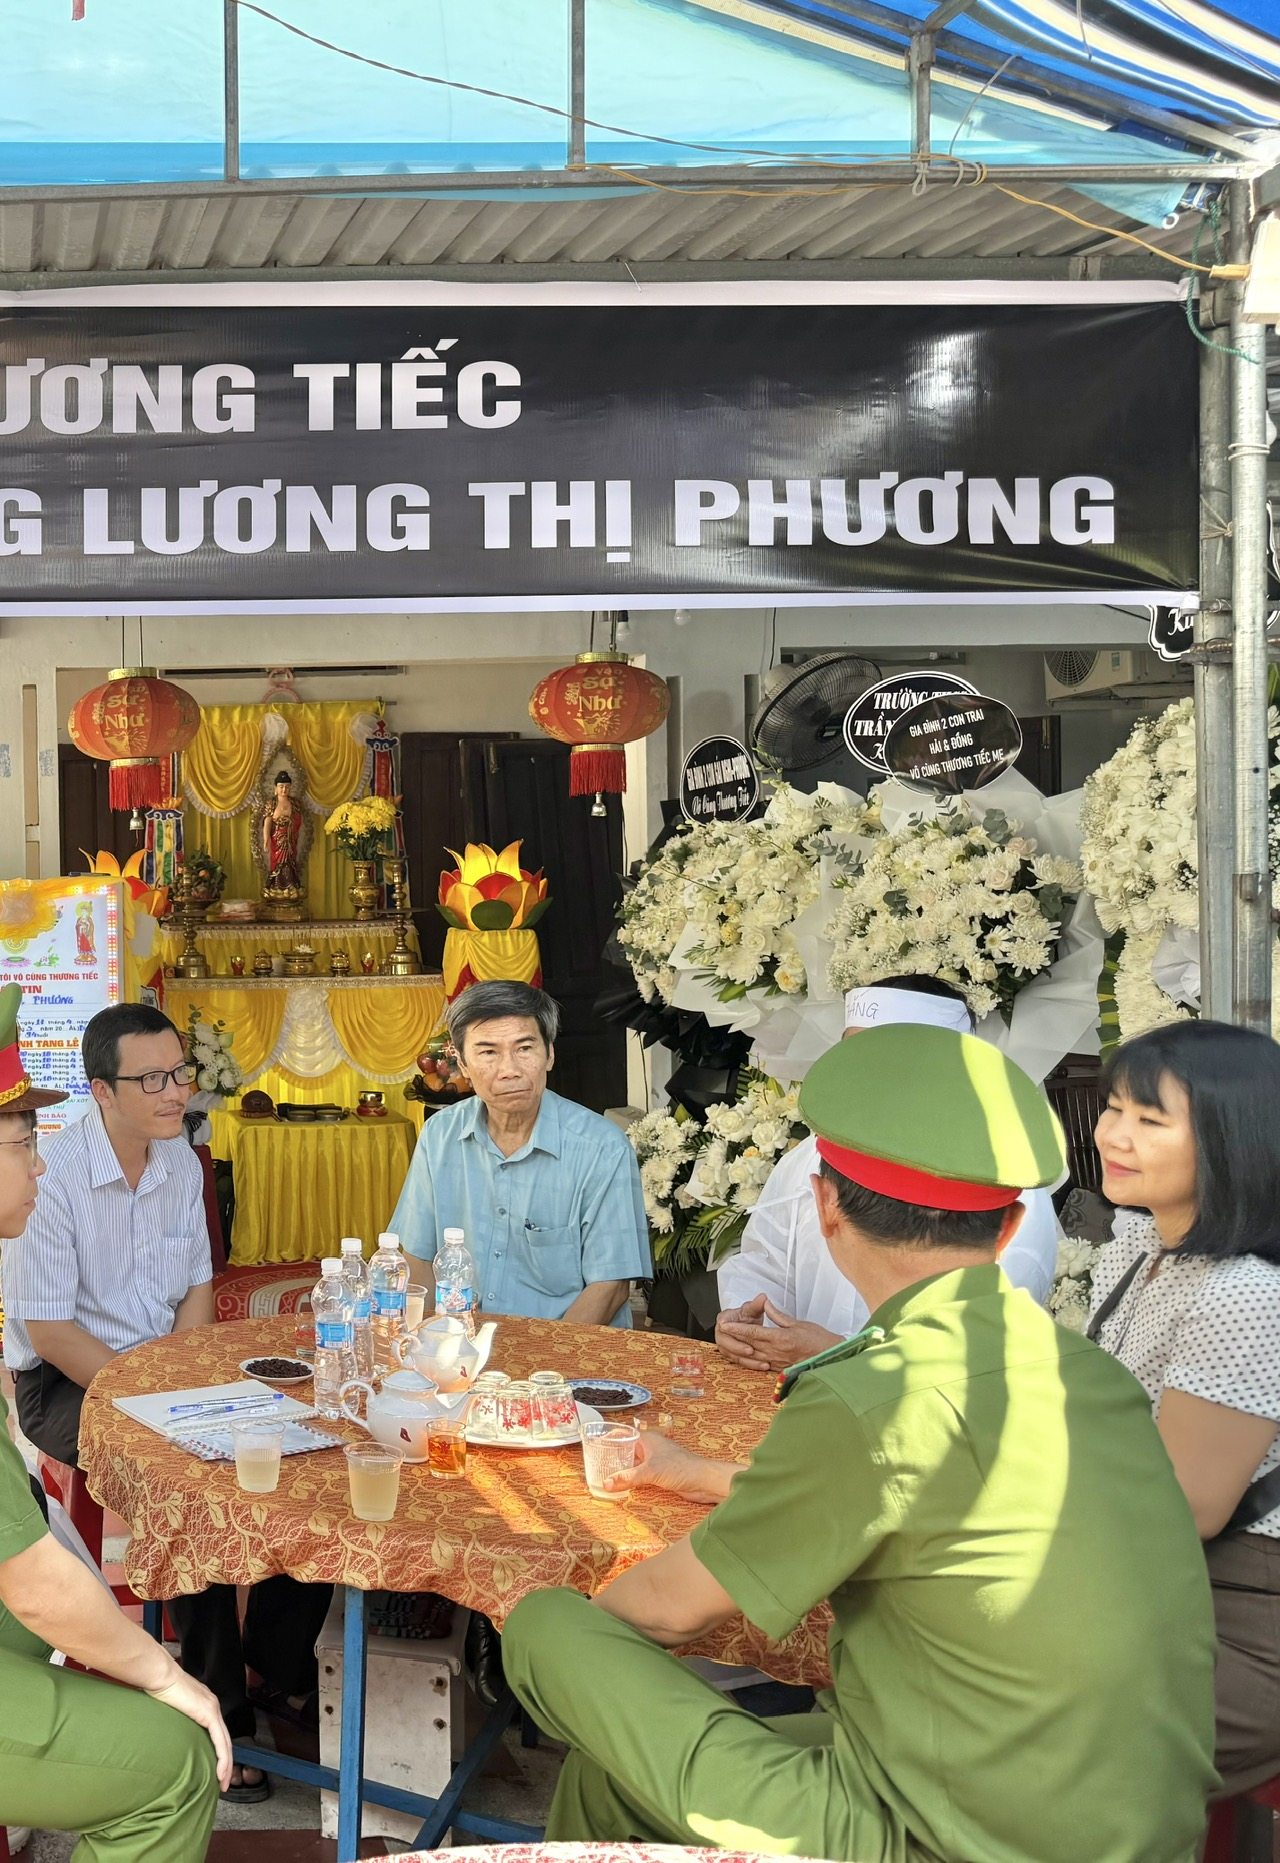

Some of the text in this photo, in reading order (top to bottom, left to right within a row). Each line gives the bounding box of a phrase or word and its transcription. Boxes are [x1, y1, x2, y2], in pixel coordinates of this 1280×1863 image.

[294, 339, 521, 430] TIẾC
[84, 479, 429, 554] LƯƠNG
[469, 480, 632, 566] THỊ
[675, 472, 1114, 546] PHƯƠNG
[909, 708, 984, 737] GIA ĐÌNH 2 CON TRAI
[944, 741, 950, 751] &
[910, 764, 920, 780] VÔ
[921, 763, 941, 778] CÙNG
[941, 756, 973, 773] THƯƠNG
[973, 748, 991, 766] TIẾC
[0, 973, 11, 981] TÔI
[13, 972, 23, 981] VÔ
[26, 972, 47, 981] CÙNG
[49, 972, 80, 980] THƯƠNG
[82, 970, 99, 980] TIẾC
[36, 1040, 64, 1048] TANG
